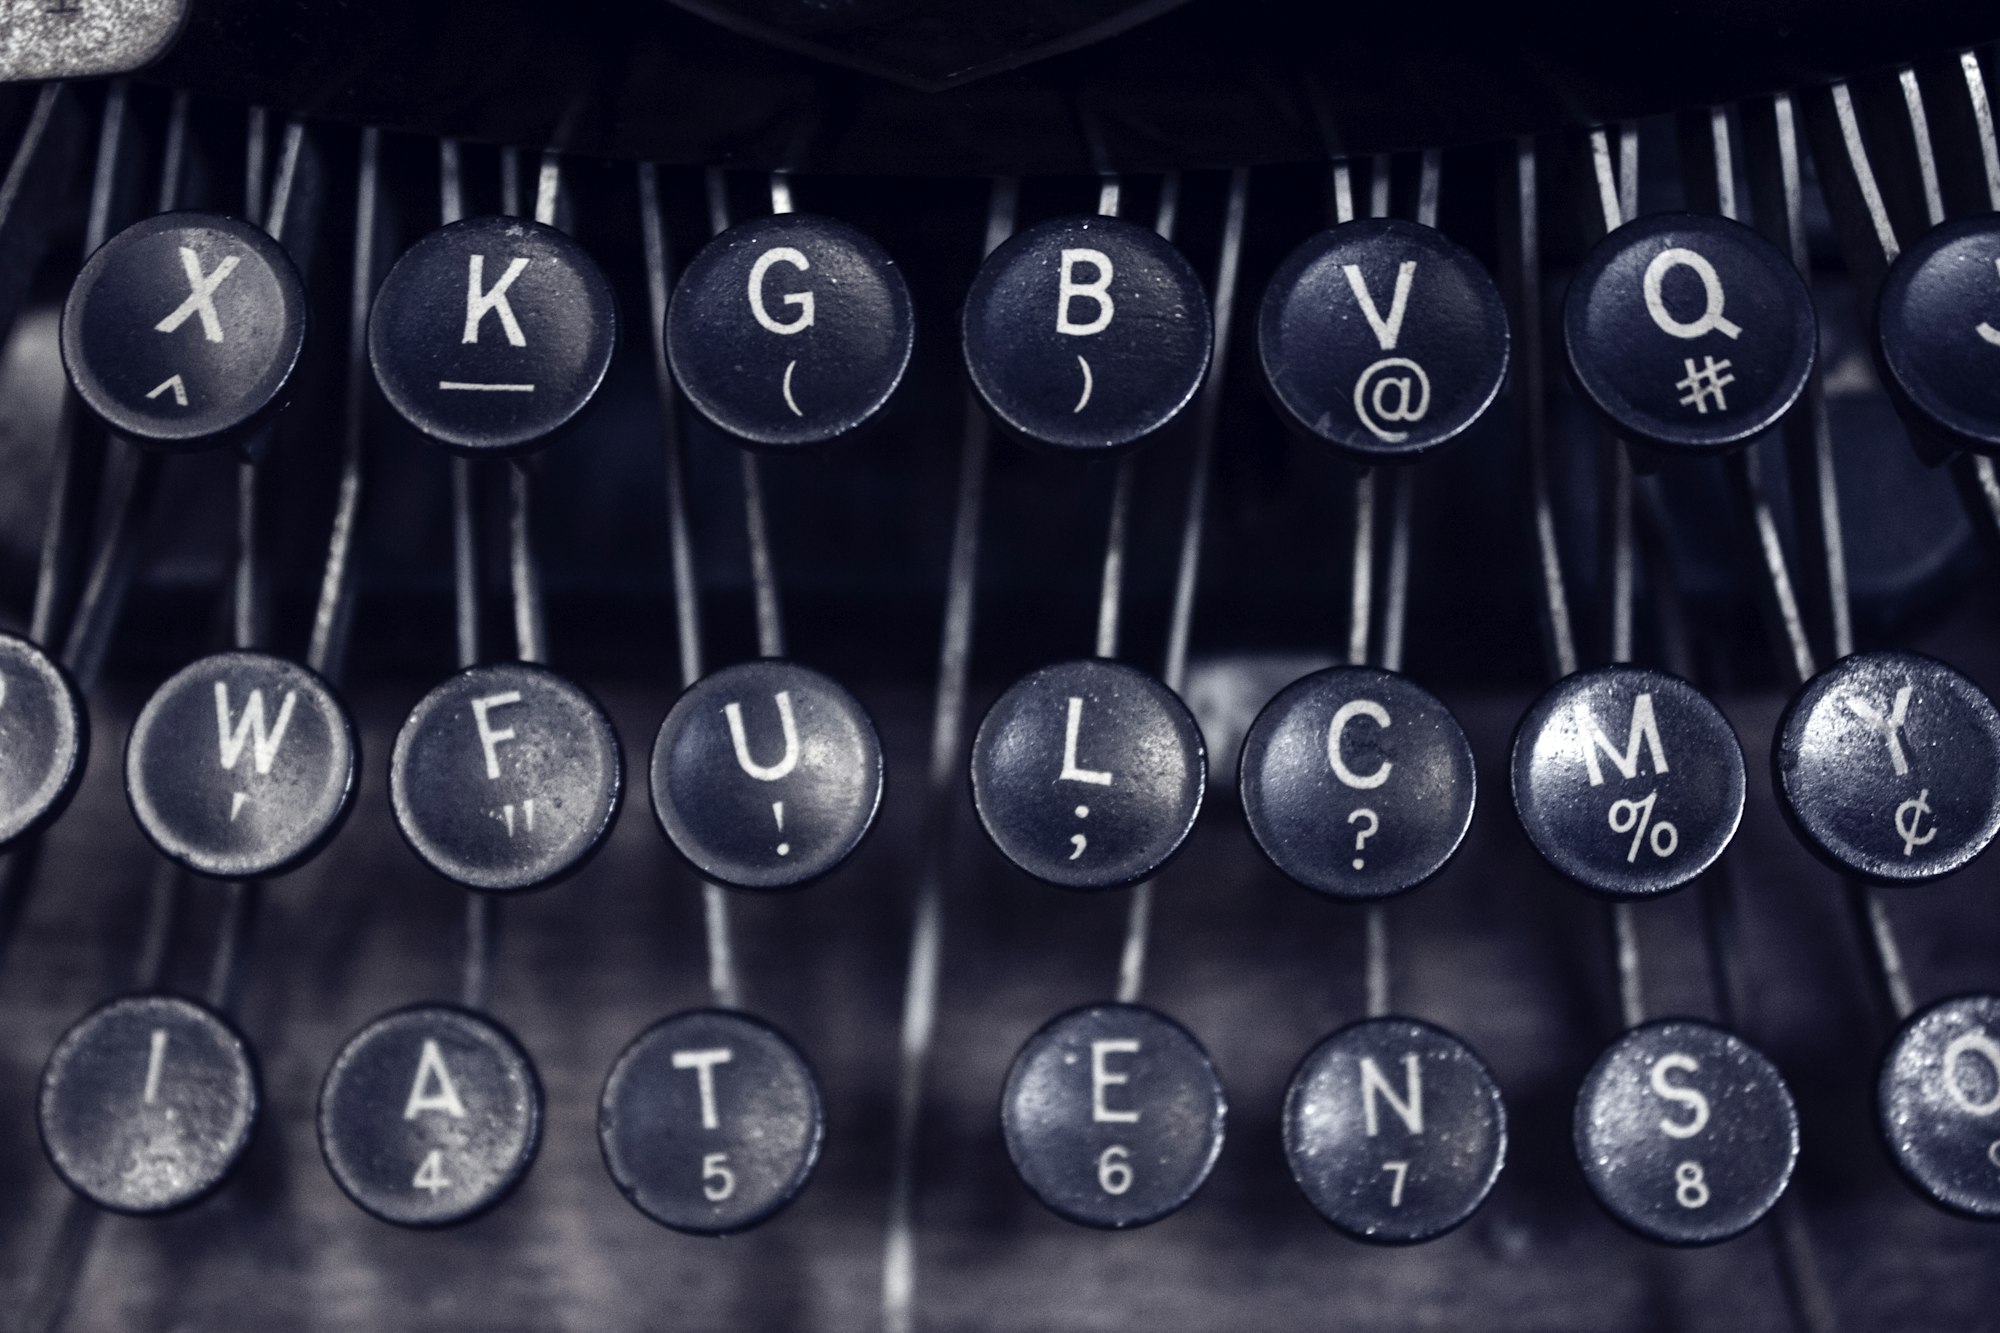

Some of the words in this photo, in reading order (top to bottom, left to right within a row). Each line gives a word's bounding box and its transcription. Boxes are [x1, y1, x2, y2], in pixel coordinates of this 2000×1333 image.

[154, 247, 240, 343] X
[461, 254, 530, 347] K
[747, 247, 815, 335] G
[1056, 248, 1115, 336] B
[1343, 260, 1417, 350] V
[1643, 247, 1742, 340] Q
[782, 359, 803, 417] (
[1073, 355, 1093, 414] )
[1353, 357, 1431, 442] @
[1675, 355, 1735, 414] #
[214, 681, 296, 774] W
[471, 690, 520, 780] F
[725, 690, 799, 781] U
[1059, 697, 1112, 786] L
[1327, 700, 1392, 790] C
[1573, 693, 1669, 787] M
[1844, 687, 1912, 776] Y
[772, 801, 789, 857] !
[1069, 805, 1089, 860] ;
[1347, 808, 1379, 871] ?
[1608, 789, 1679, 863] %
[1894, 788, 1937, 856] ¢
[403, 1038, 466, 1120] A
[672, 1048, 733, 1129] T
[1092, 1039, 1140, 1123] E
[1359, 1053, 1423, 1137] N
[1651, 1053, 1710, 1139] S
[412, 1150, 450, 1196] 4
[702, 1153, 735, 1201] 5
[1098, 1145, 1133, 1195] 6
[1382, 1162, 1408, 1207] 7
[1674, 1161, 1709, 1209] 8
